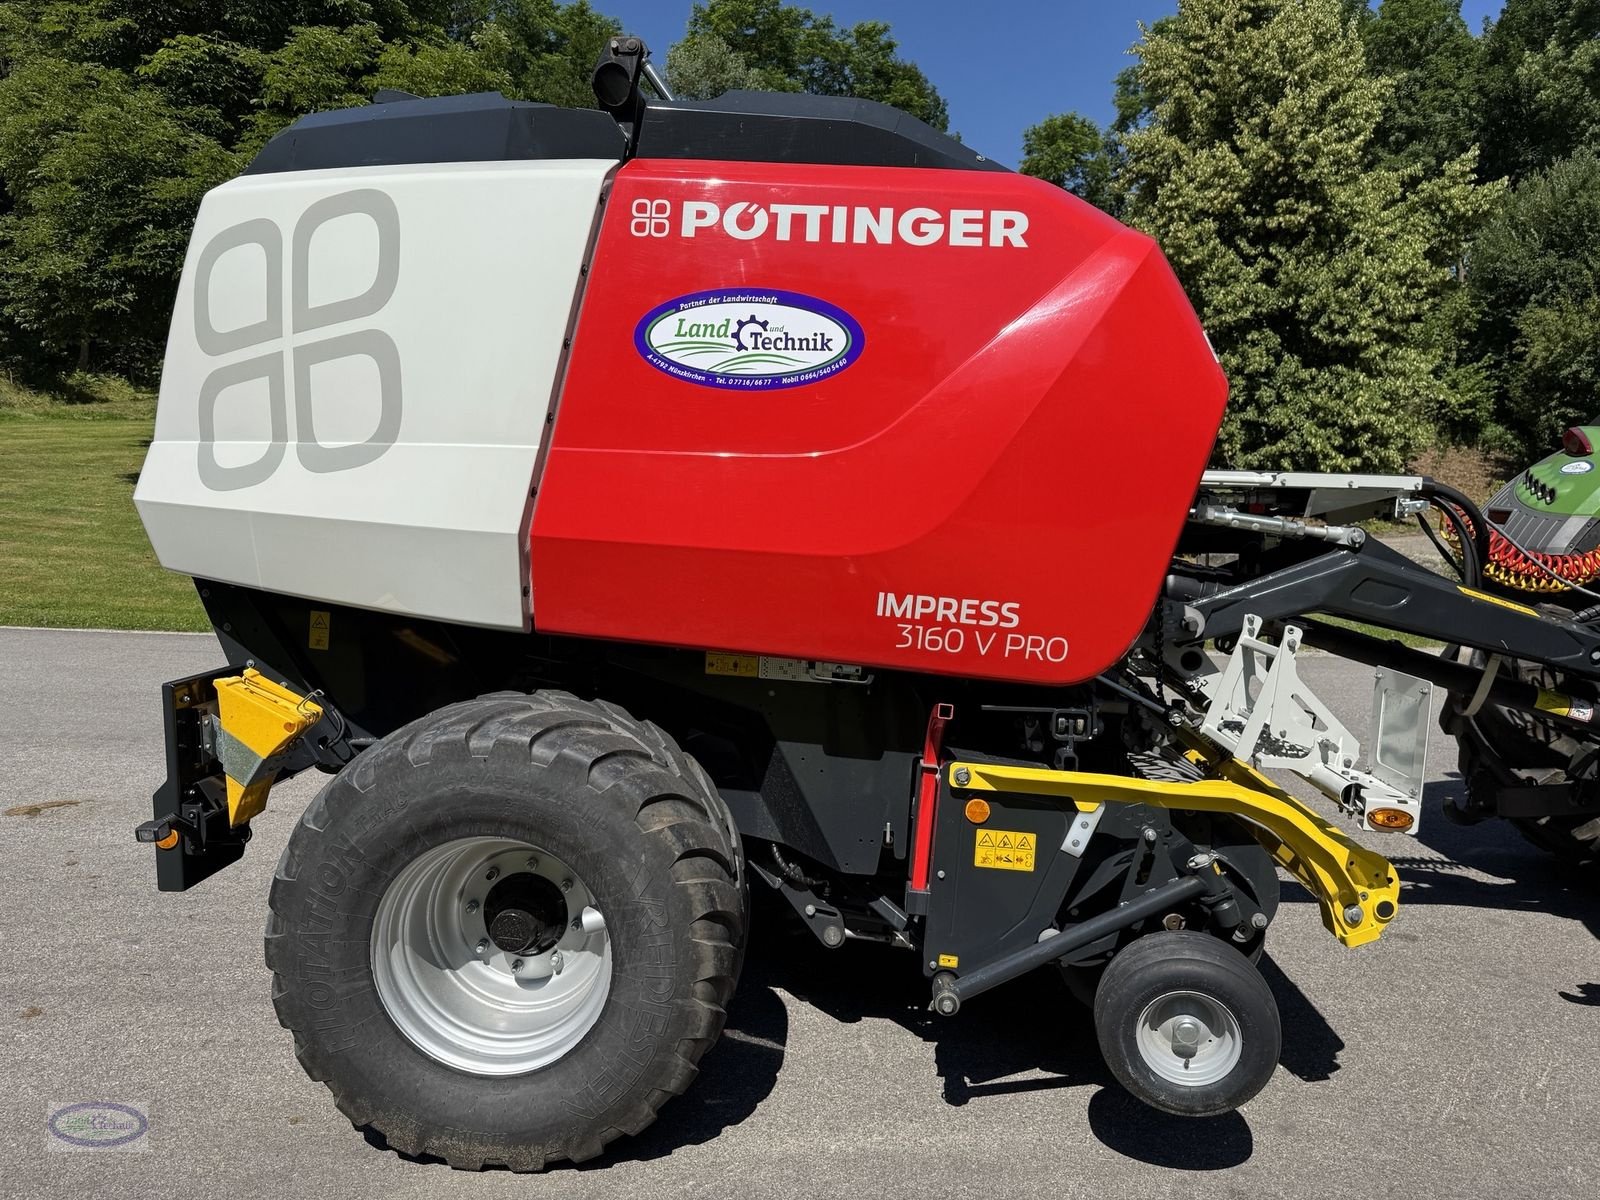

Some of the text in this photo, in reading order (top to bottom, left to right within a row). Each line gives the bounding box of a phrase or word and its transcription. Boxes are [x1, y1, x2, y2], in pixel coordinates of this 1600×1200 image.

[681, 201, 1029, 248] PÖTTINGER
[680, 295, 778, 310] Partner der Landwirtschaft
[675, 318, 730, 338] Land
[750, 332, 833, 351] Technik
[782, 376, 799, 384] Mobil
[876, 592, 1020, 628] IMPRESS
[895, 624, 1069, 662] 3160 V PRO
[296, 831, 366, 1054] FLOTATION
[560, 862, 678, 1121] VREDESTEIN
